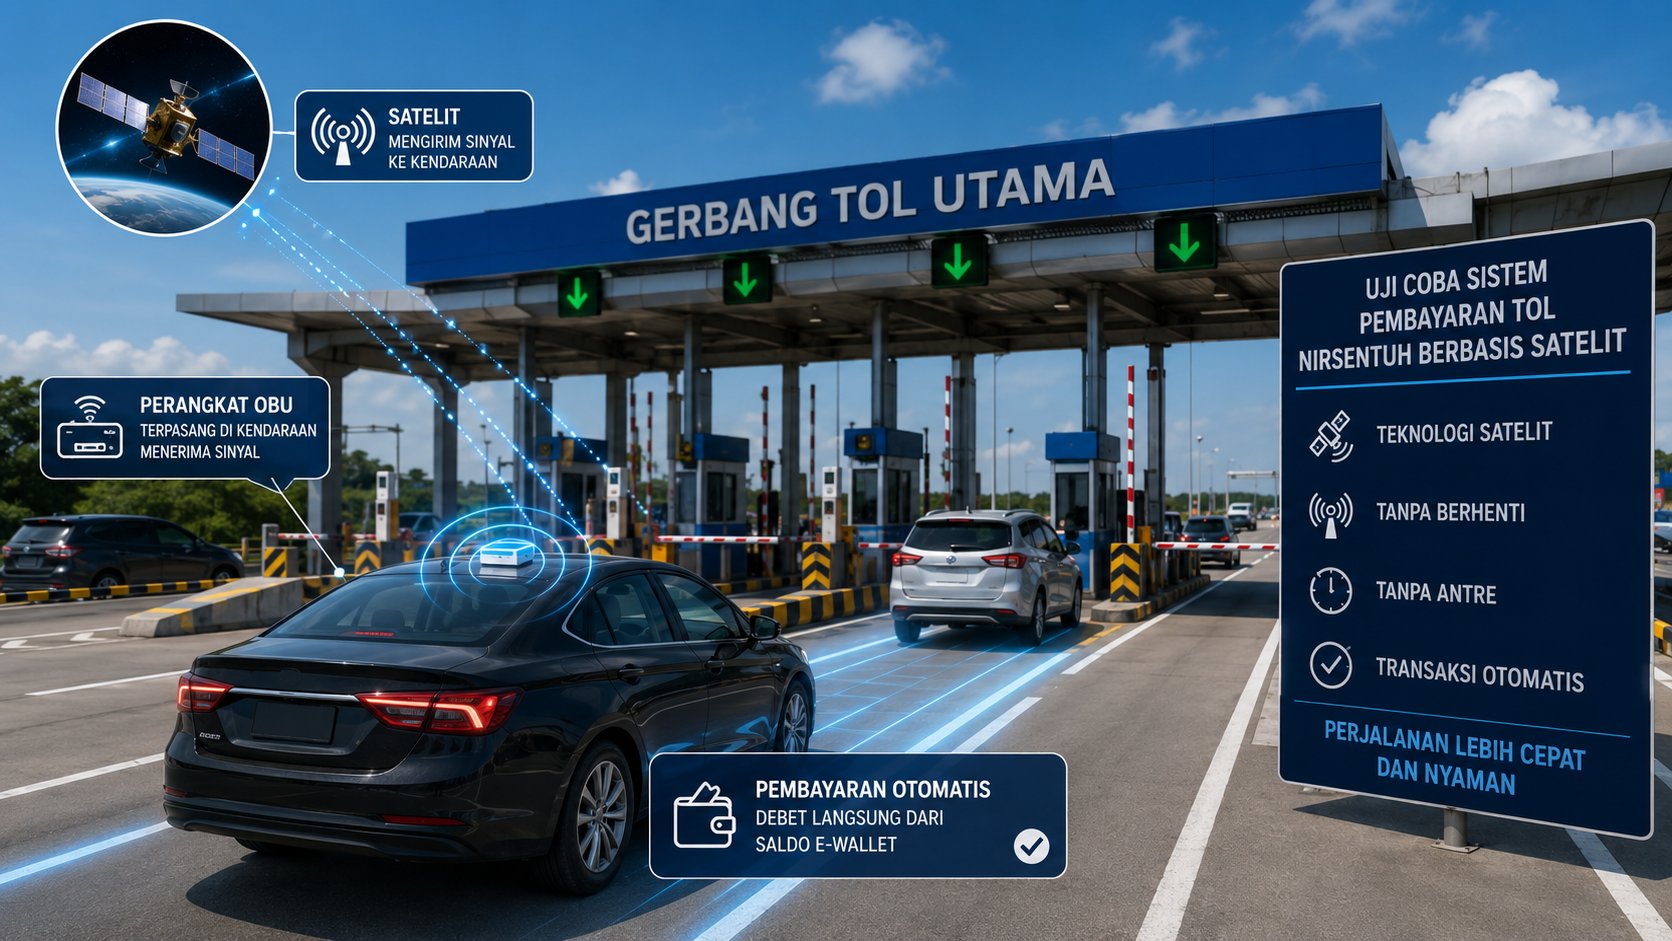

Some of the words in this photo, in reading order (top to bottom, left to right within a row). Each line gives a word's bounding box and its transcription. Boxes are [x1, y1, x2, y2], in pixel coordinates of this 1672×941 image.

[628, 191, 816, 243] GERBANG
[832, 181, 916, 222] TOL
[935, 159, 1114, 212] UTAMA
[1367, 276, 1396, 299] UJI
[1404, 270, 1460, 295] COBA
[1467, 259, 1546, 289] SISTEM
[1361, 301, 1503, 334] PEMBAYARAN
[1512, 296, 1555, 321] TOL
[1300, 344, 1411, 371] NIRSENTUH
[1420, 336, 1523, 364] BERBASIS
[1531, 328, 1626, 357] SATELIT
[1377, 424, 1473, 443] TEKNOLOGI
[1481, 422, 1552, 441] SATELIT
[1377, 503, 1431, 520] TANPA
[1438, 503, 1524, 521] BERHENTI
[1377, 581, 1431, 601] TANPA
[1437, 584, 1496, 604] ANTRE
[1376, 658, 1475, 683] TRANSAKSI
[1483, 666, 1583, 692] OTOMATIS
[1326, 720, 1448, 753] PERJALANAN
[1456, 735, 1512, 761] LEBIH
[1521, 744, 1585, 770] CEPAT
[1378, 757, 1417, 781] DAN
[1425, 763, 1514, 795] NYAMAN
